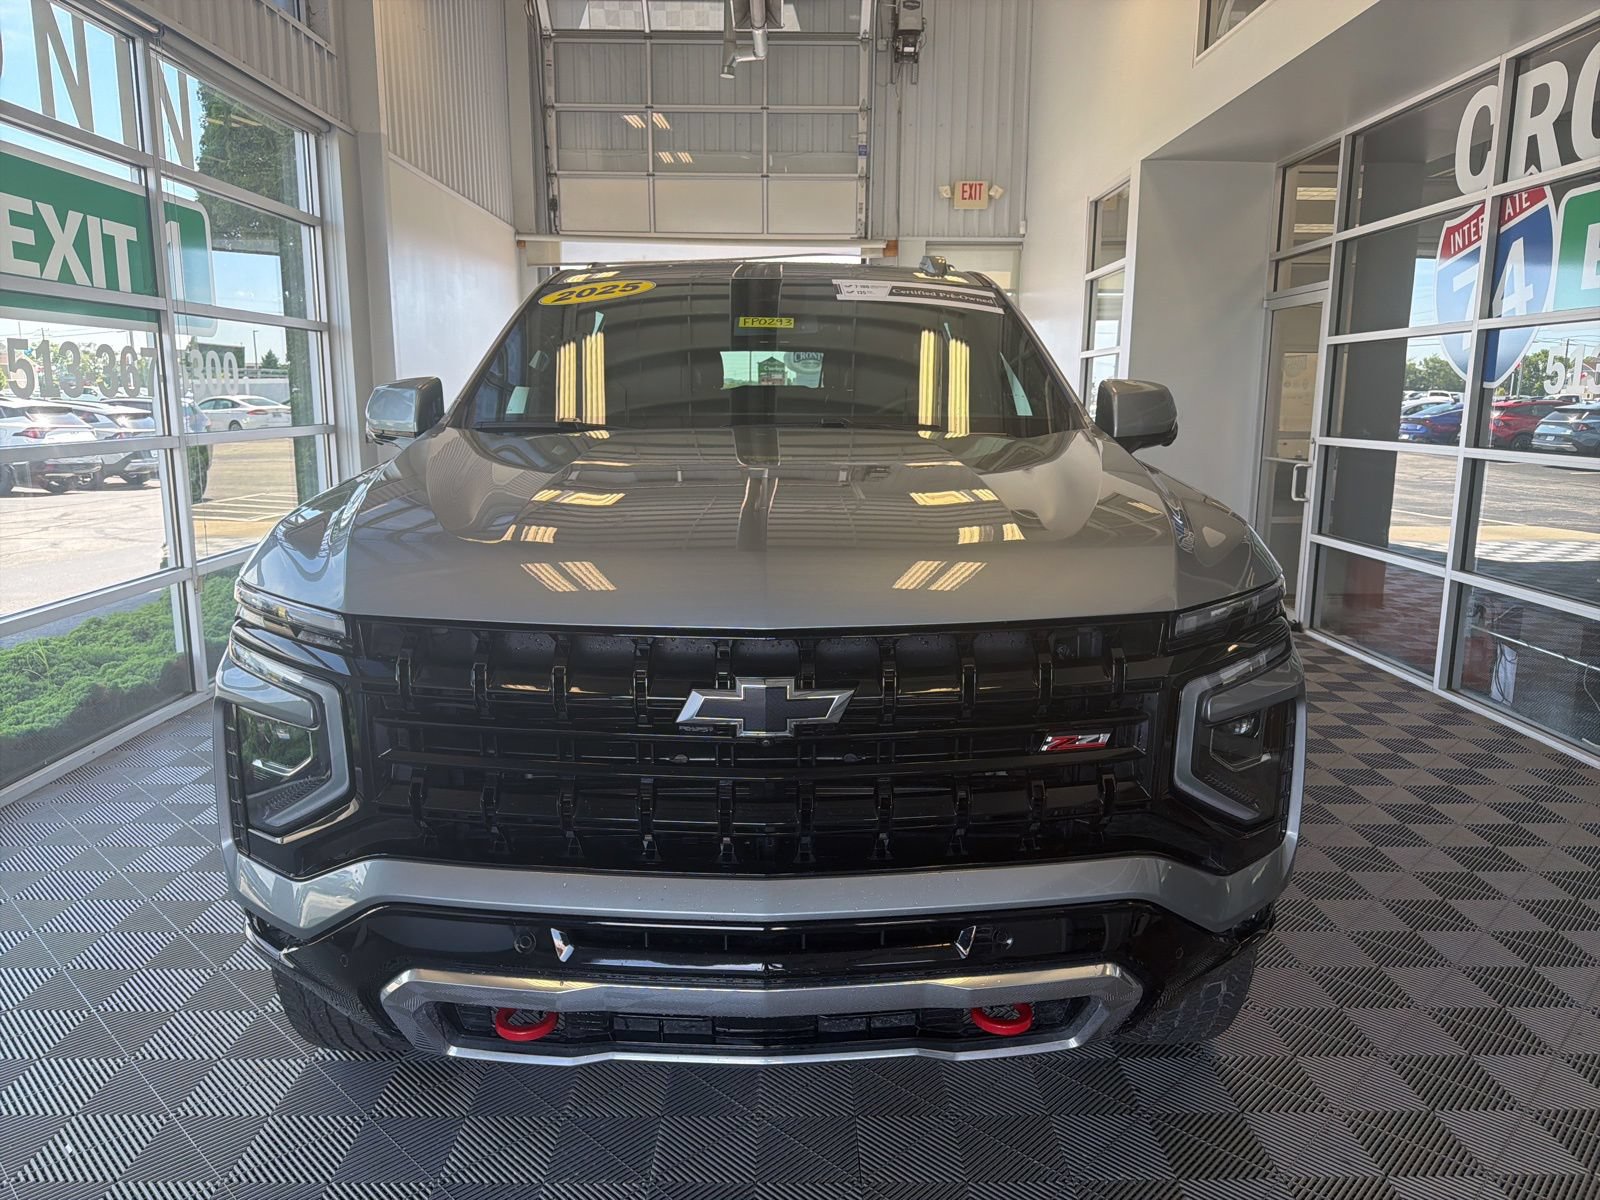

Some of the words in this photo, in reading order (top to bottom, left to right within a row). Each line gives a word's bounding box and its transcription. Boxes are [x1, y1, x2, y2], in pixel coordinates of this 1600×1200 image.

[962, 183, 983, 200] EXIT
[1450, 191, 1531, 255] INTERATE
[0, 191, 137, 294] EXIT
[551, 281, 643, 303] 2025
[892, 288, 937, 297] Certified
[939, 291, 993, 304] Pre-Owned
[1452, 236, 1534, 350] 74
[1040, 732, 1111, 752] Z71
